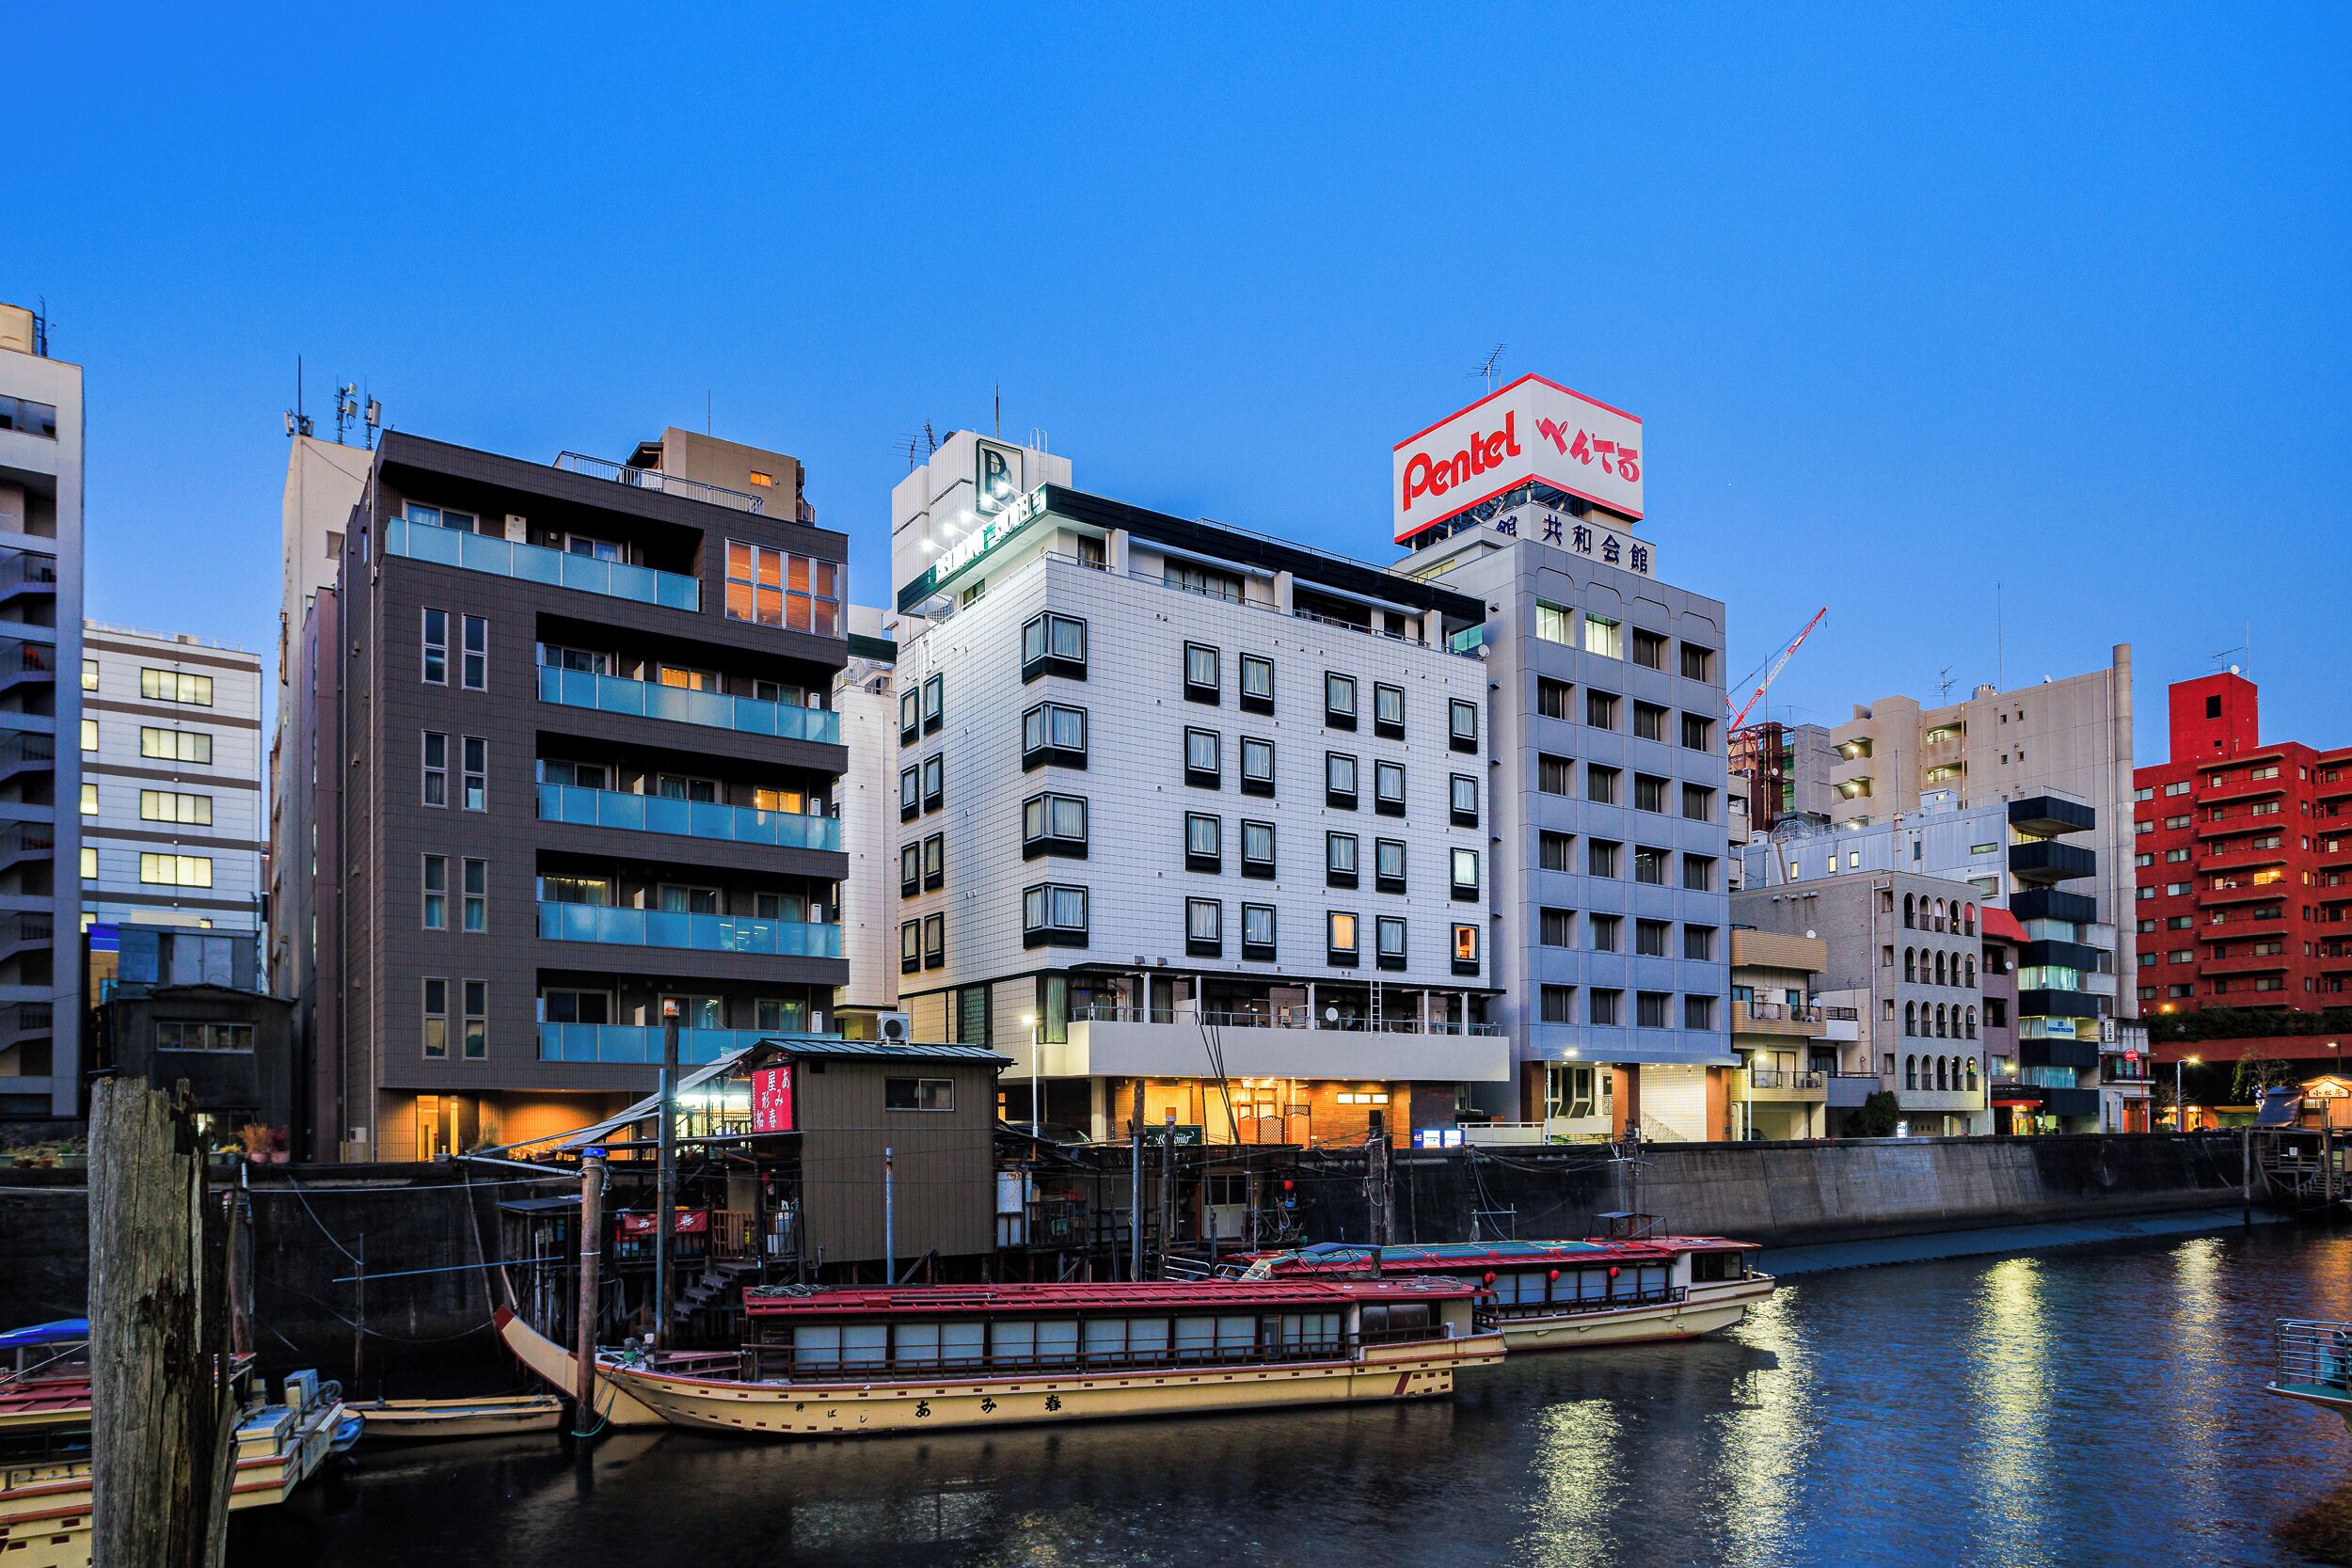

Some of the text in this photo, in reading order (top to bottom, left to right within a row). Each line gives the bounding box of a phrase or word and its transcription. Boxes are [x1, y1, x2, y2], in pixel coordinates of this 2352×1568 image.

[1403, 410, 1520, 512] Pentel
[1542, 514, 1648, 574] 共和会館
[756, 1070, 776, 1129] 屋形船
[769, 1069, 790, 1129] あみ春
[915, 1395, 1061, 1418] あみ春
